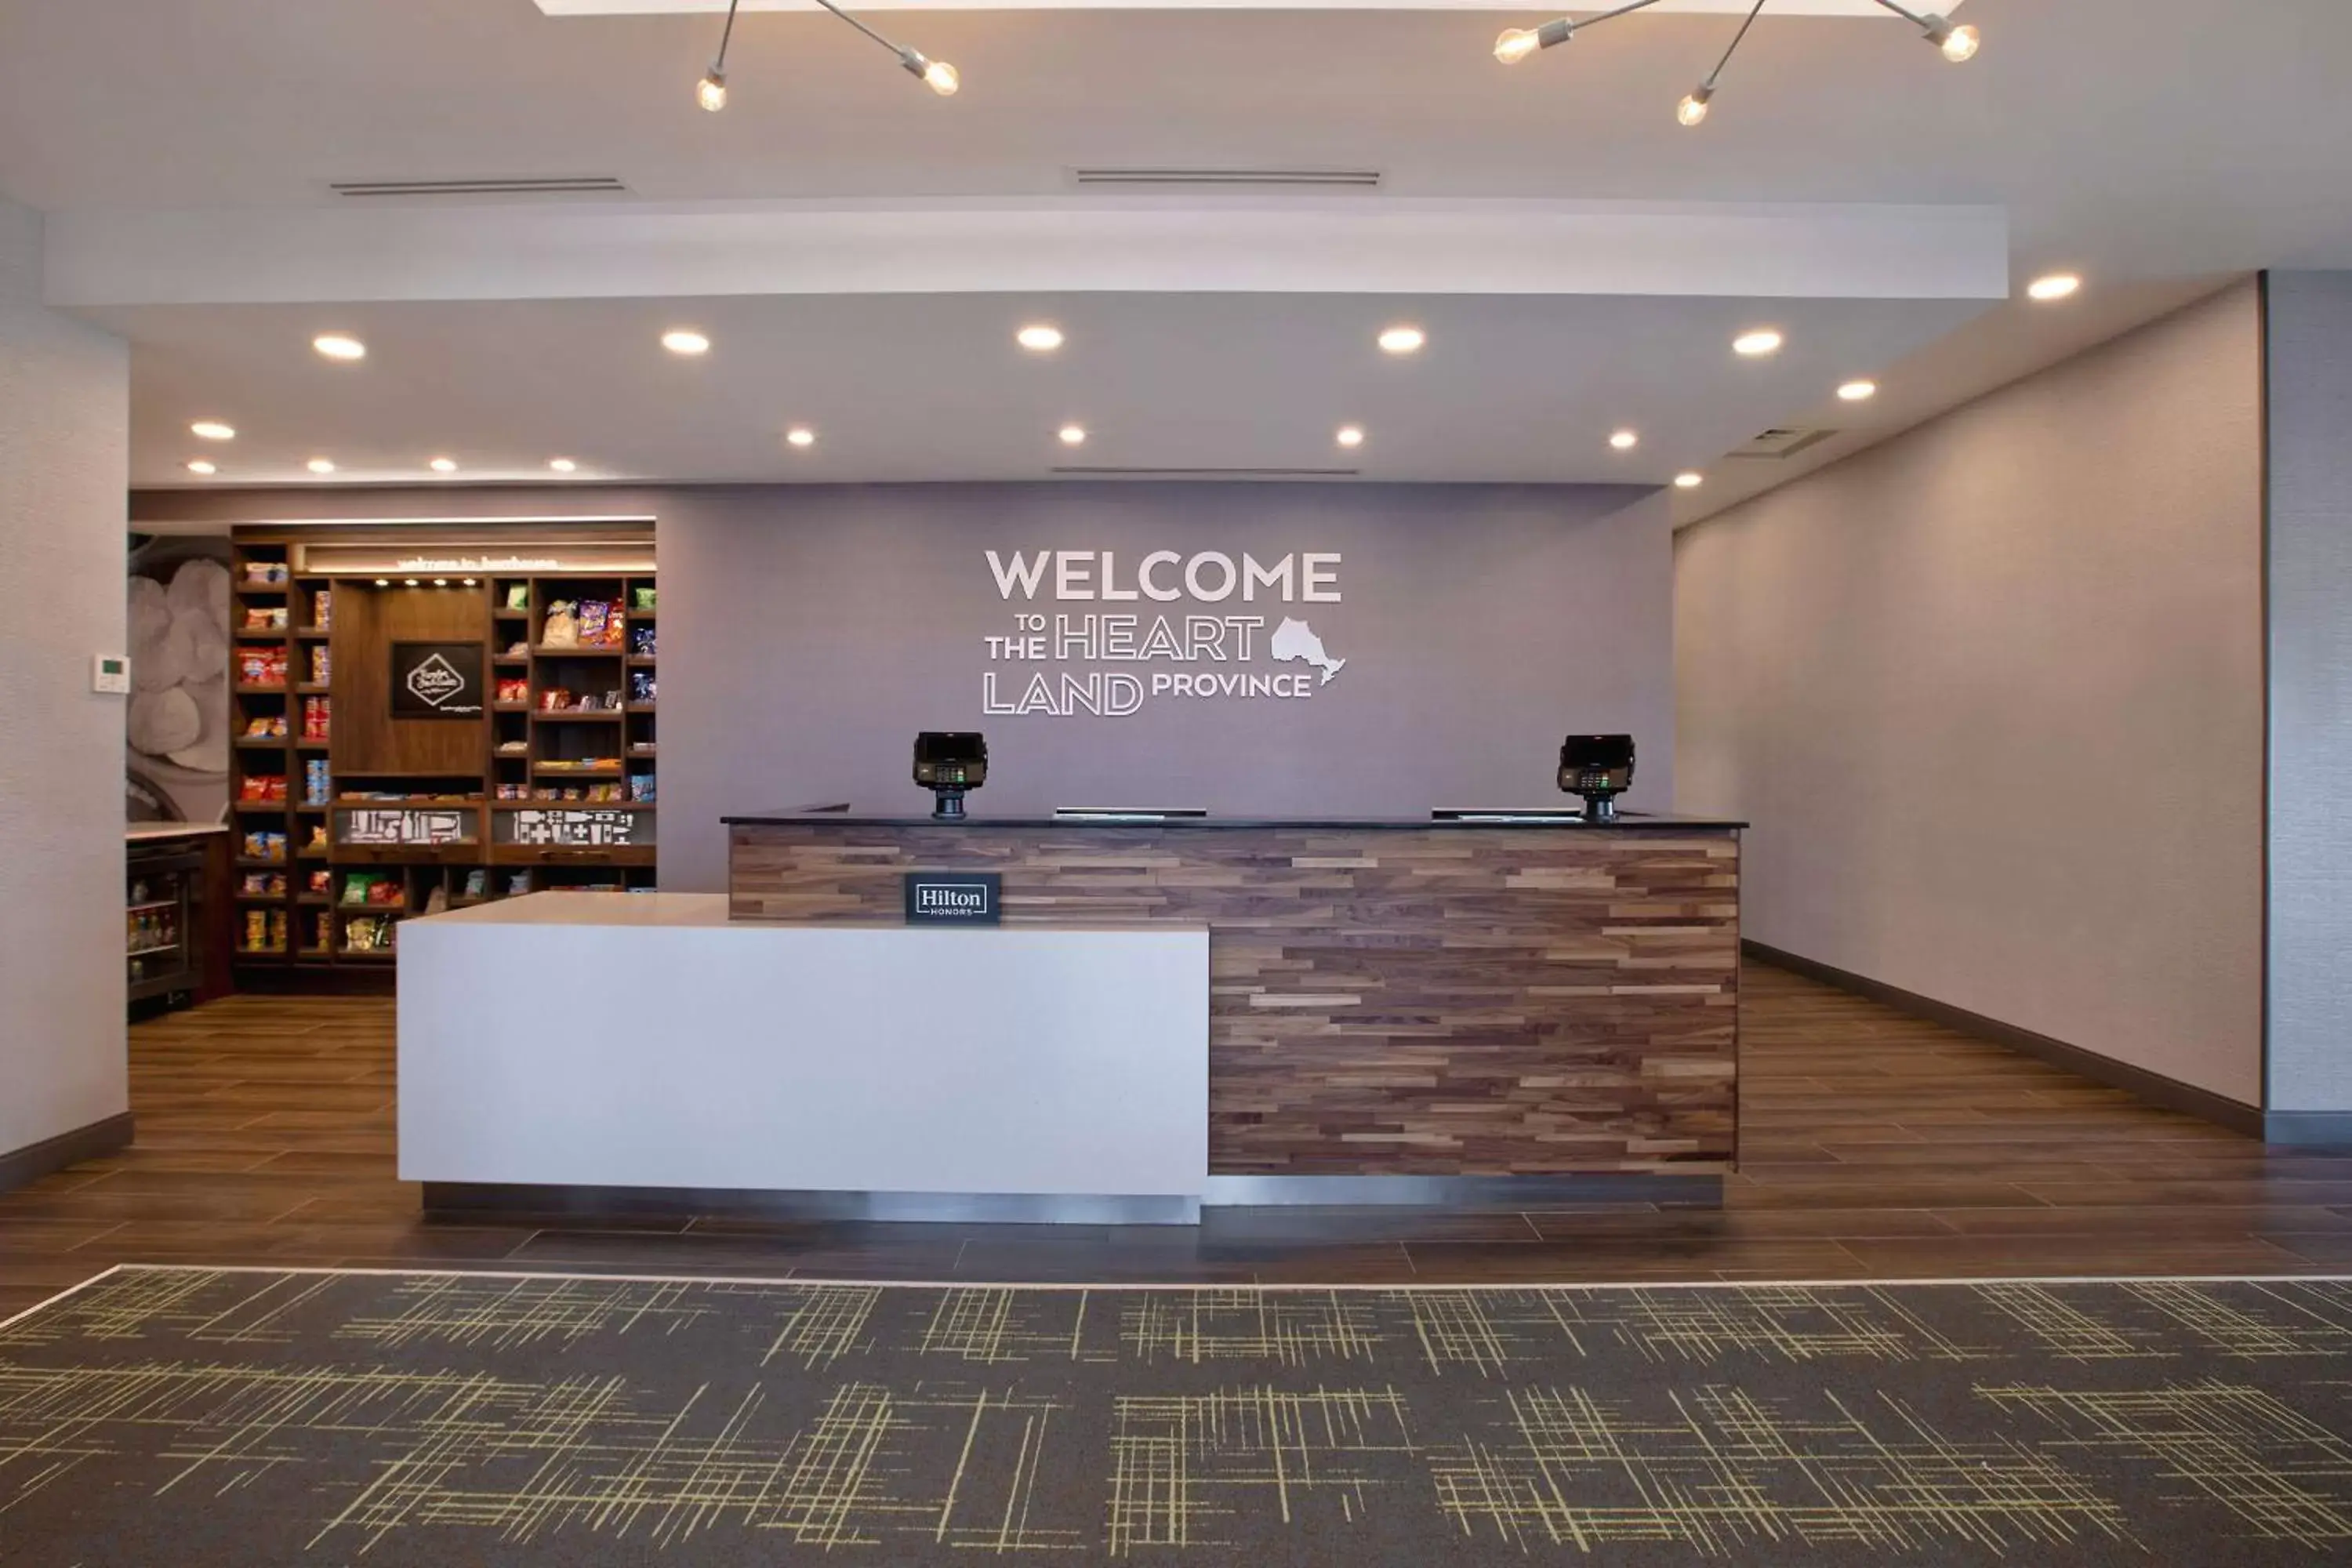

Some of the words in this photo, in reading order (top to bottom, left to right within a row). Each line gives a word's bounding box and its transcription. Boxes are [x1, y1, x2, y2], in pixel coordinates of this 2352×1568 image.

[985, 550, 1341, 602] WELCOME
[985, 637, 1047, 659] THE
[1055, 614, 1265, 661] HEART
[1014, 614, 1046, 631] TO
[983, 672, 1145, 717] LAND
[1152, 673, 1312, 697] PROVINCE
[922, 890, 980, 906] Hilton
